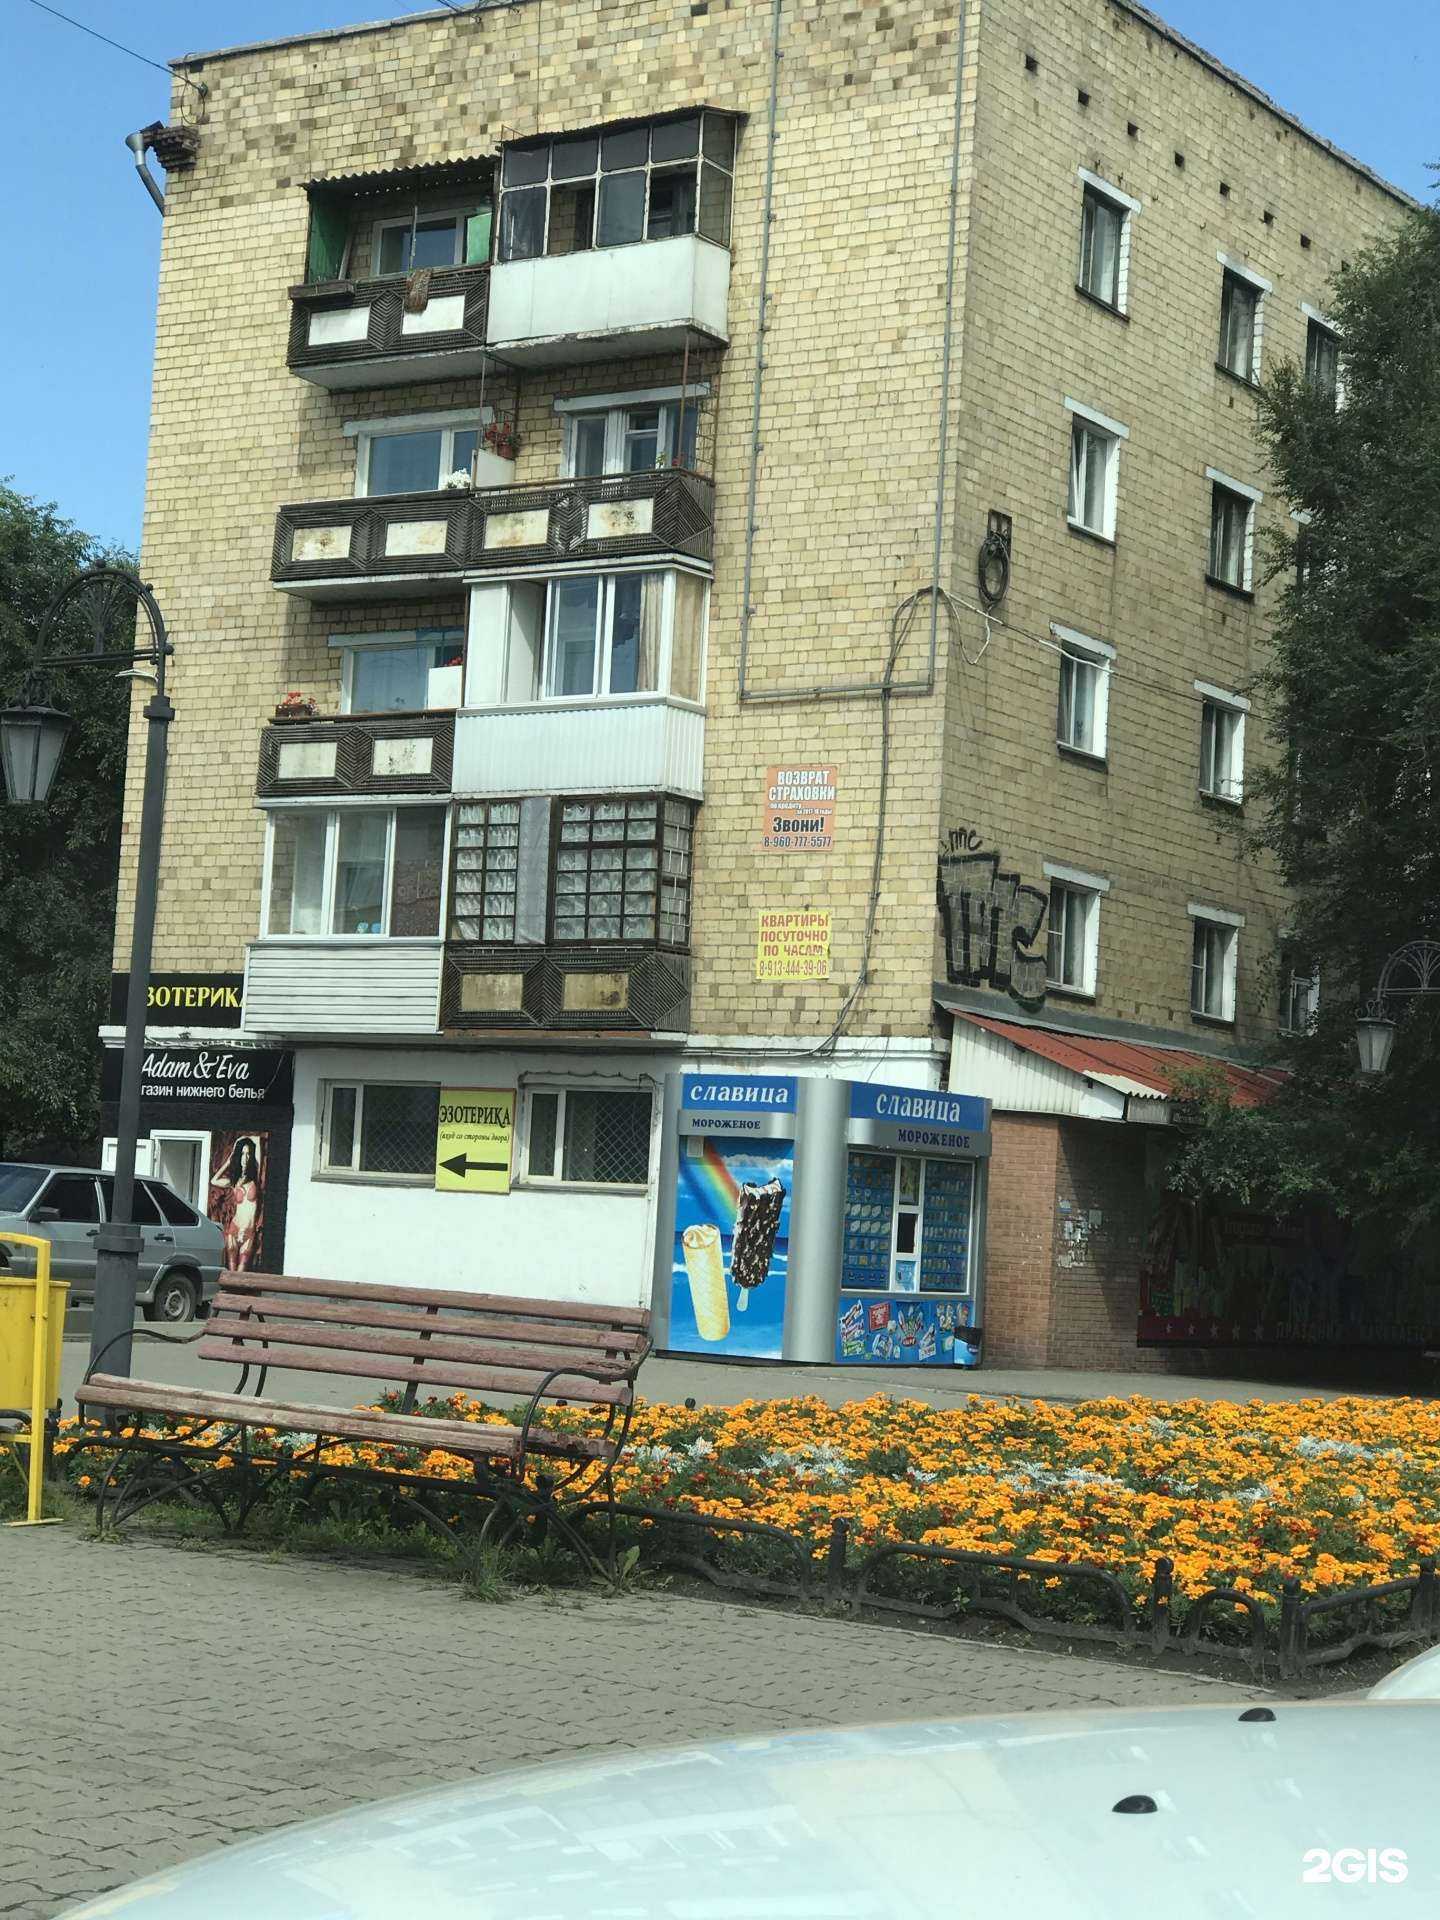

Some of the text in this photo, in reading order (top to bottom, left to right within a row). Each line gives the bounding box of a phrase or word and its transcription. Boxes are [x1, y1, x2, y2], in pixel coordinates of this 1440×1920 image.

[777, 770, 830, 785] ВОЗВРАТ
[768, 786, 835, 801] СТРАХОВКИ
[773, 816, 825, 833] Звони!
[764, 836, 832, 848] 8-960-777-5577
[761, 914, 829, 928] КВАРТИРЫ
[760, 930, 828, 943] ПОСУТОЧНО
[763, 945, 779, 957] ПО
[760, 959, 827, 977] 8-913-444-39-06
[146, 986, 246, 1008] ЗОТЕРИК
[141, 1084, 266, 1100] газин нижнего белья
[439, 1105, 511, 1128] ЭЗОТЕРИКА
[691, 1118, 761, 1130] МОРОЖЕНОЕ
[897, 1128, 970, 1149] МОРОЖЕНОЕ
